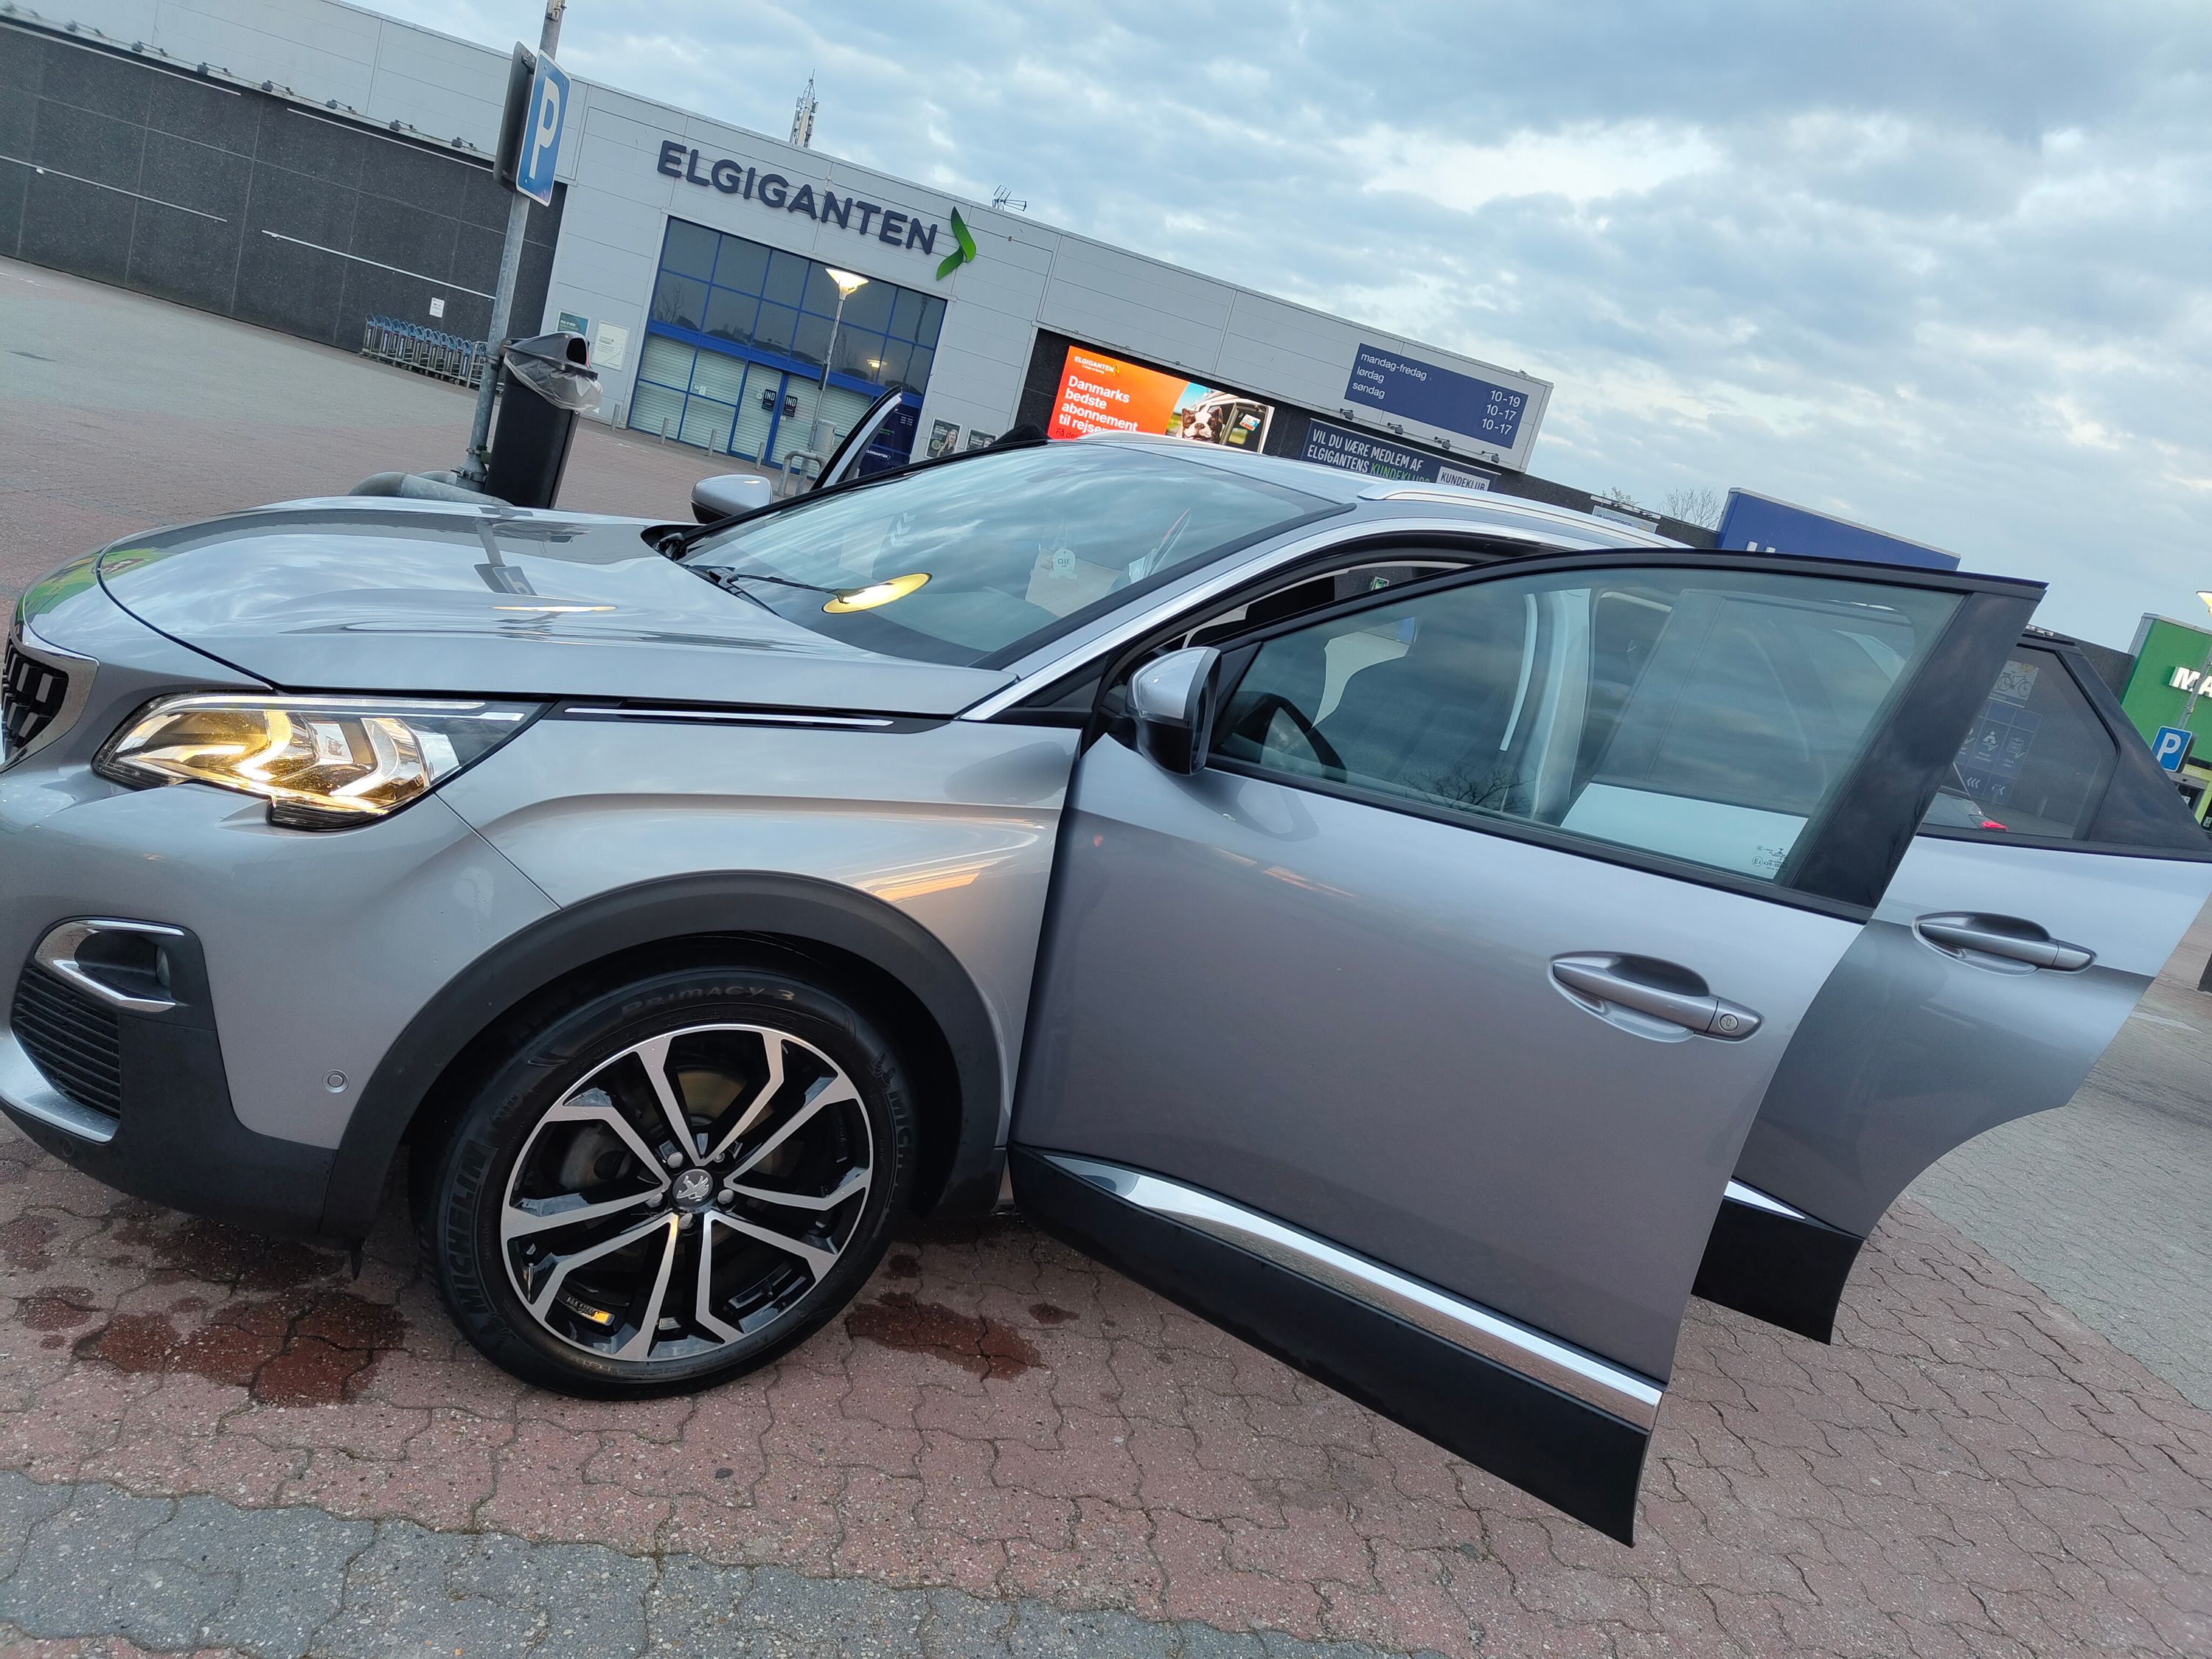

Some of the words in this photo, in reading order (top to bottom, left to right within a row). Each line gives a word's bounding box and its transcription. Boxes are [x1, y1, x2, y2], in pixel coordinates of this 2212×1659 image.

[529, 76, 560, 180] P
[657, 139, 938, 255] ELGIGANTEN
[1074, 355, 1114, 373] ELGIGANTEN
[1068, 375, 1130, 403] Danmarks
[1356, 365, 1385, 383] lørdag
[1486, 403, 1517, 422] 10-17
[1360, 352, 1427, 381] mandag-fredag
[1490, 389, 1521, 408] 10-19
[765, 390, 776, 401] IND
[785, 396, 796, 407] IND
[1064, 387, 1107, 409] bedste
[1352, 381, 1385, 400] søndag
[1481, 417, 1513, 436] 10-17
[1059, 413, 1071, 427] til
[1061, 402, 1138, 432] abonnement
[1307, 445, 1370, 473] ELGIGANTENS
[1312, 428, 1326, 445] VIL
[1328, 433, 1343, 449] DU
[1344, 437, 1369, 457] VÆRE
[1370, 446, 1411, 468] MEDLEM
[1410, 459, 1424, 473] AF
[2156, 732, 2182, 763] P
[773, 989, 796, 1001] 3
[446, 1139, 488, 1315] MICHELIN
